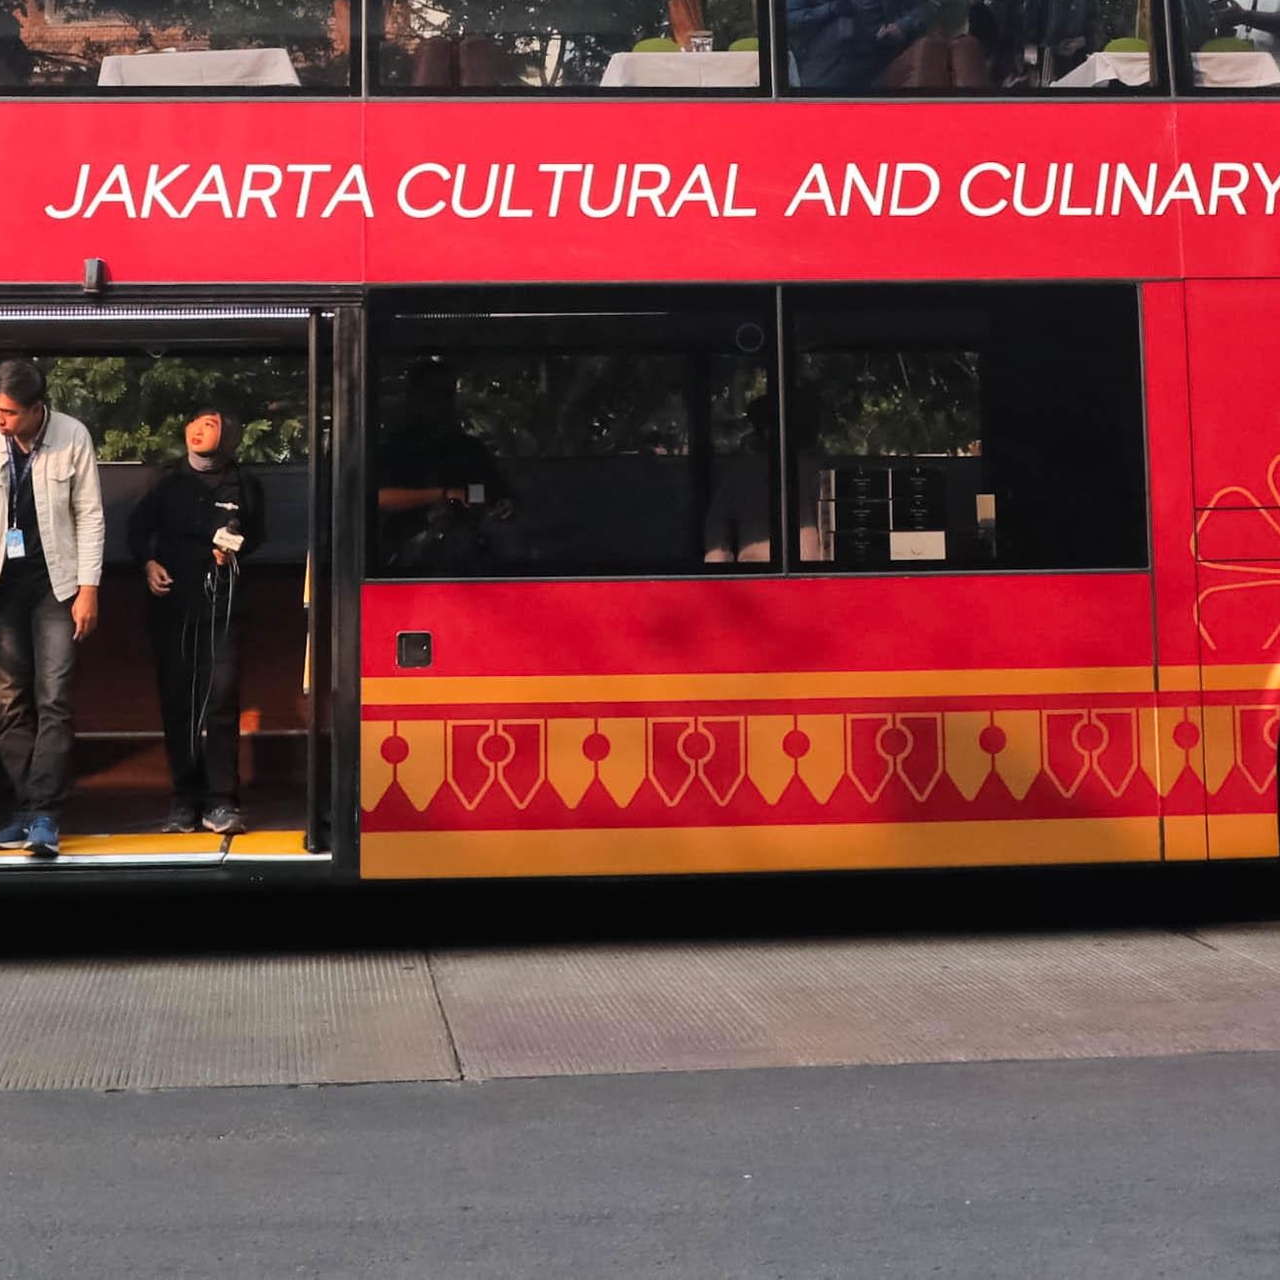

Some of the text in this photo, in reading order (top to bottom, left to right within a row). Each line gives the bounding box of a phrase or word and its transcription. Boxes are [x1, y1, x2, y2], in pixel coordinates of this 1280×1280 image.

[44, 163, 375, 219] JAKARTA
[397, 162, 757, 219] CULTURAL
[784, 162, 940, 217] AND
